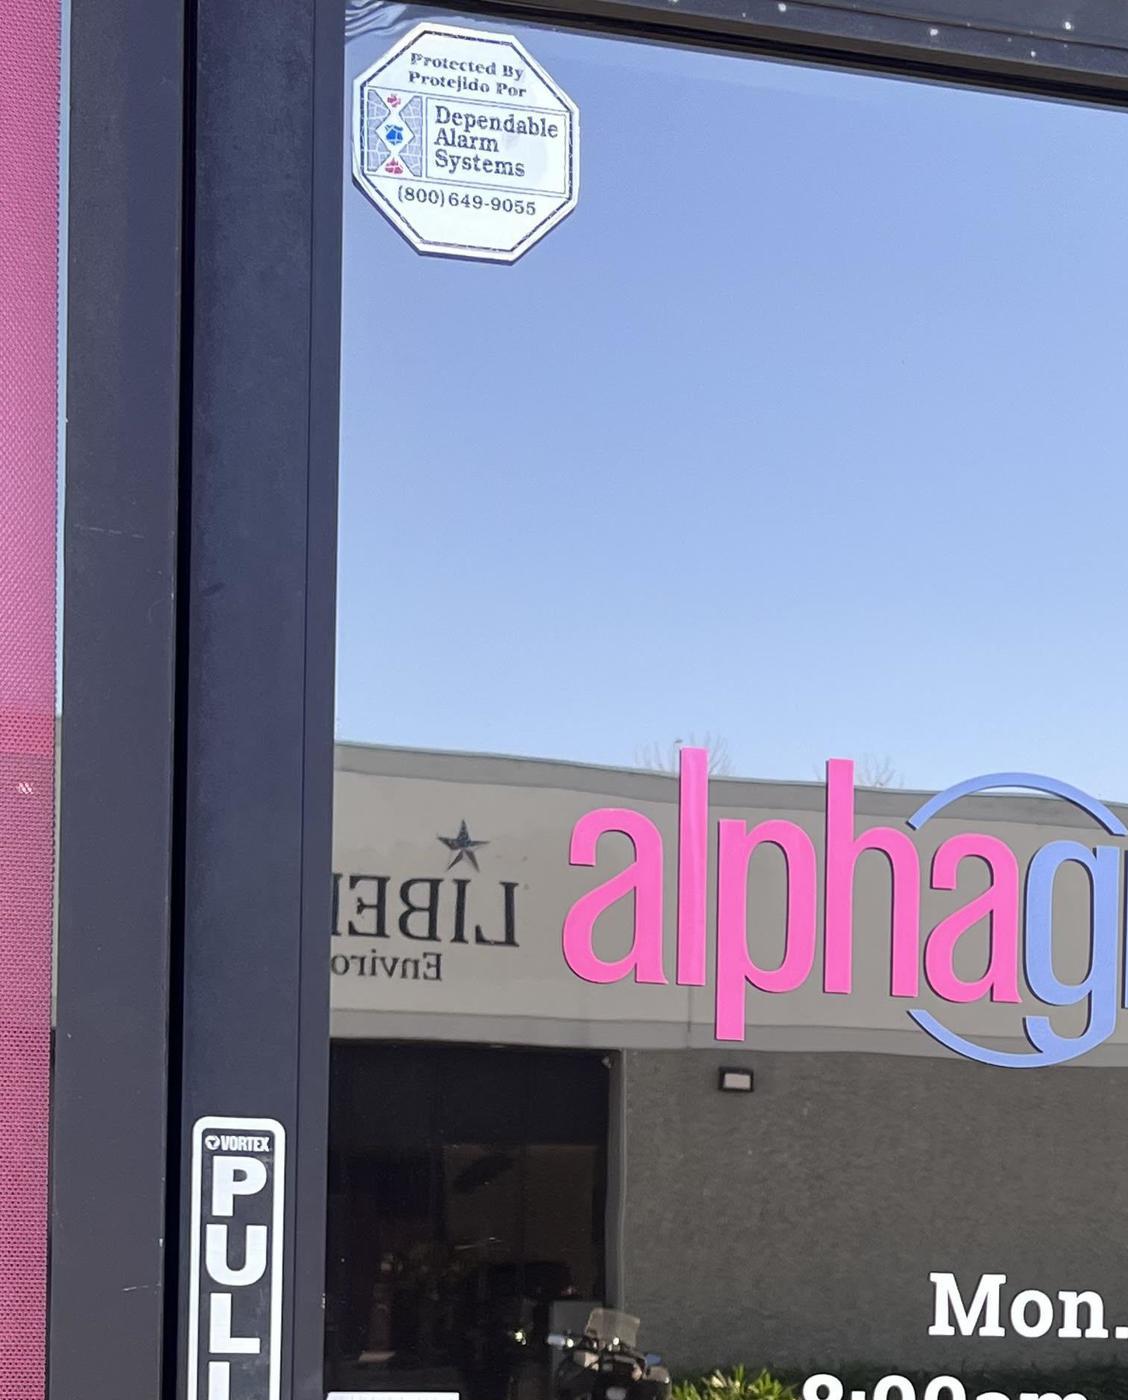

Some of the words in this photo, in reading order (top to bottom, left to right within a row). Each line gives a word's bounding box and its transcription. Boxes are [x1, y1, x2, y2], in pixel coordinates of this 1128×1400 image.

[409, 52, 497, 76] Protected
[502, 63, 526, 82] By
[408, 71, 491, 93] Protejido
[495, 81, 528, 98] Por
[435, 105, 559, 139] Dependable
[434, 127, 500, 153] Alarm
[434, 149, 527, 178] Systems
[220, 1135, 270, 1153] VORTEX
